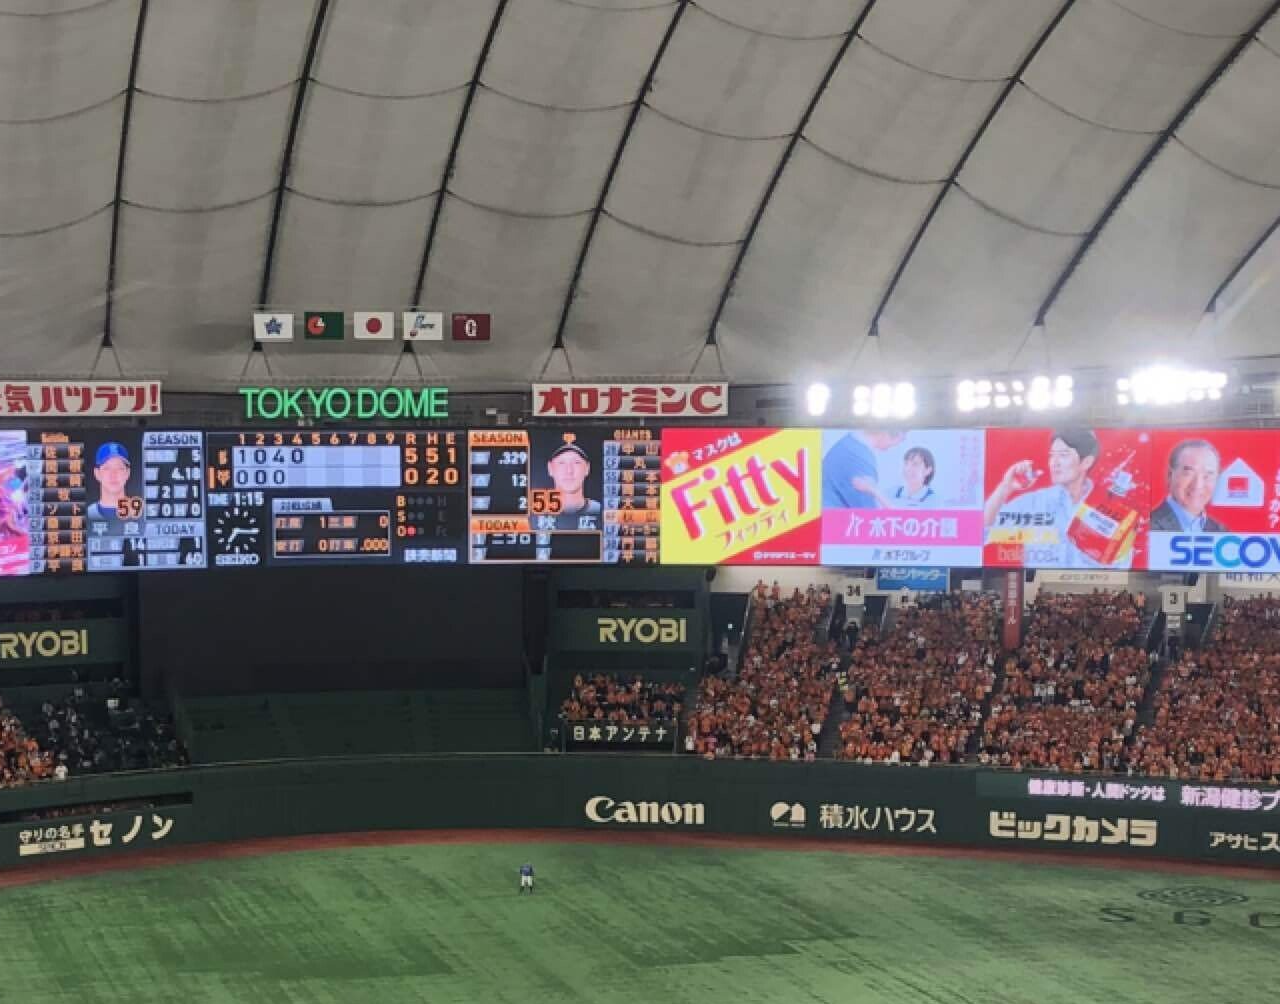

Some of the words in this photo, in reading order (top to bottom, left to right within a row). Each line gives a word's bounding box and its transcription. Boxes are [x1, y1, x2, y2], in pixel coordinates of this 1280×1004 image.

[239, 387, 351, 419] TOKYO
[358, 387, 449, 418] DOME
[538, 385, 722, 414] オロナミンC
[149, 434, 198, 445] SEASON
[473, 433, 523, 443] SEASON
[692, 432, 743, 461] マスクは
[239, 449, 246, 463] 1
[254, 449, 266, 464] 0
[273, 449, 285, 464] 4
[291, 449, 304, 464] 0
[405, 447, 418, 464] 5
[426, 447, 439, 464] 5
[447, 447, 455, 464] 1
[237, 469, 248, 484] 0
[255, 469, 267, 484] 0
[273, 469, 285, 484] 0
[405, 467, 418, 485] 0
[426, 467, 439, 485] 2
[444, 467, 458, 485] 0
[533, 491, 561, 513] 55
[671, 447, 809, 541] Fitty
[117, 499, 142, 518] 59
[999, 512, 1056, 527] アリナミン
[478, 520, 518, 531] TODAY
[869, 517, 958, 539] 木下の介護
[598, 617, 687, 644] RYOBI
[574, 724, 668, 742] 日本アンテナ
[585, 795, 705, 825] Canon
[819, 804, 937, 834] 積水ハウス
[90, 813, 174, 847] セノン
[989, 810, 1157, 847] ビックカメラ
